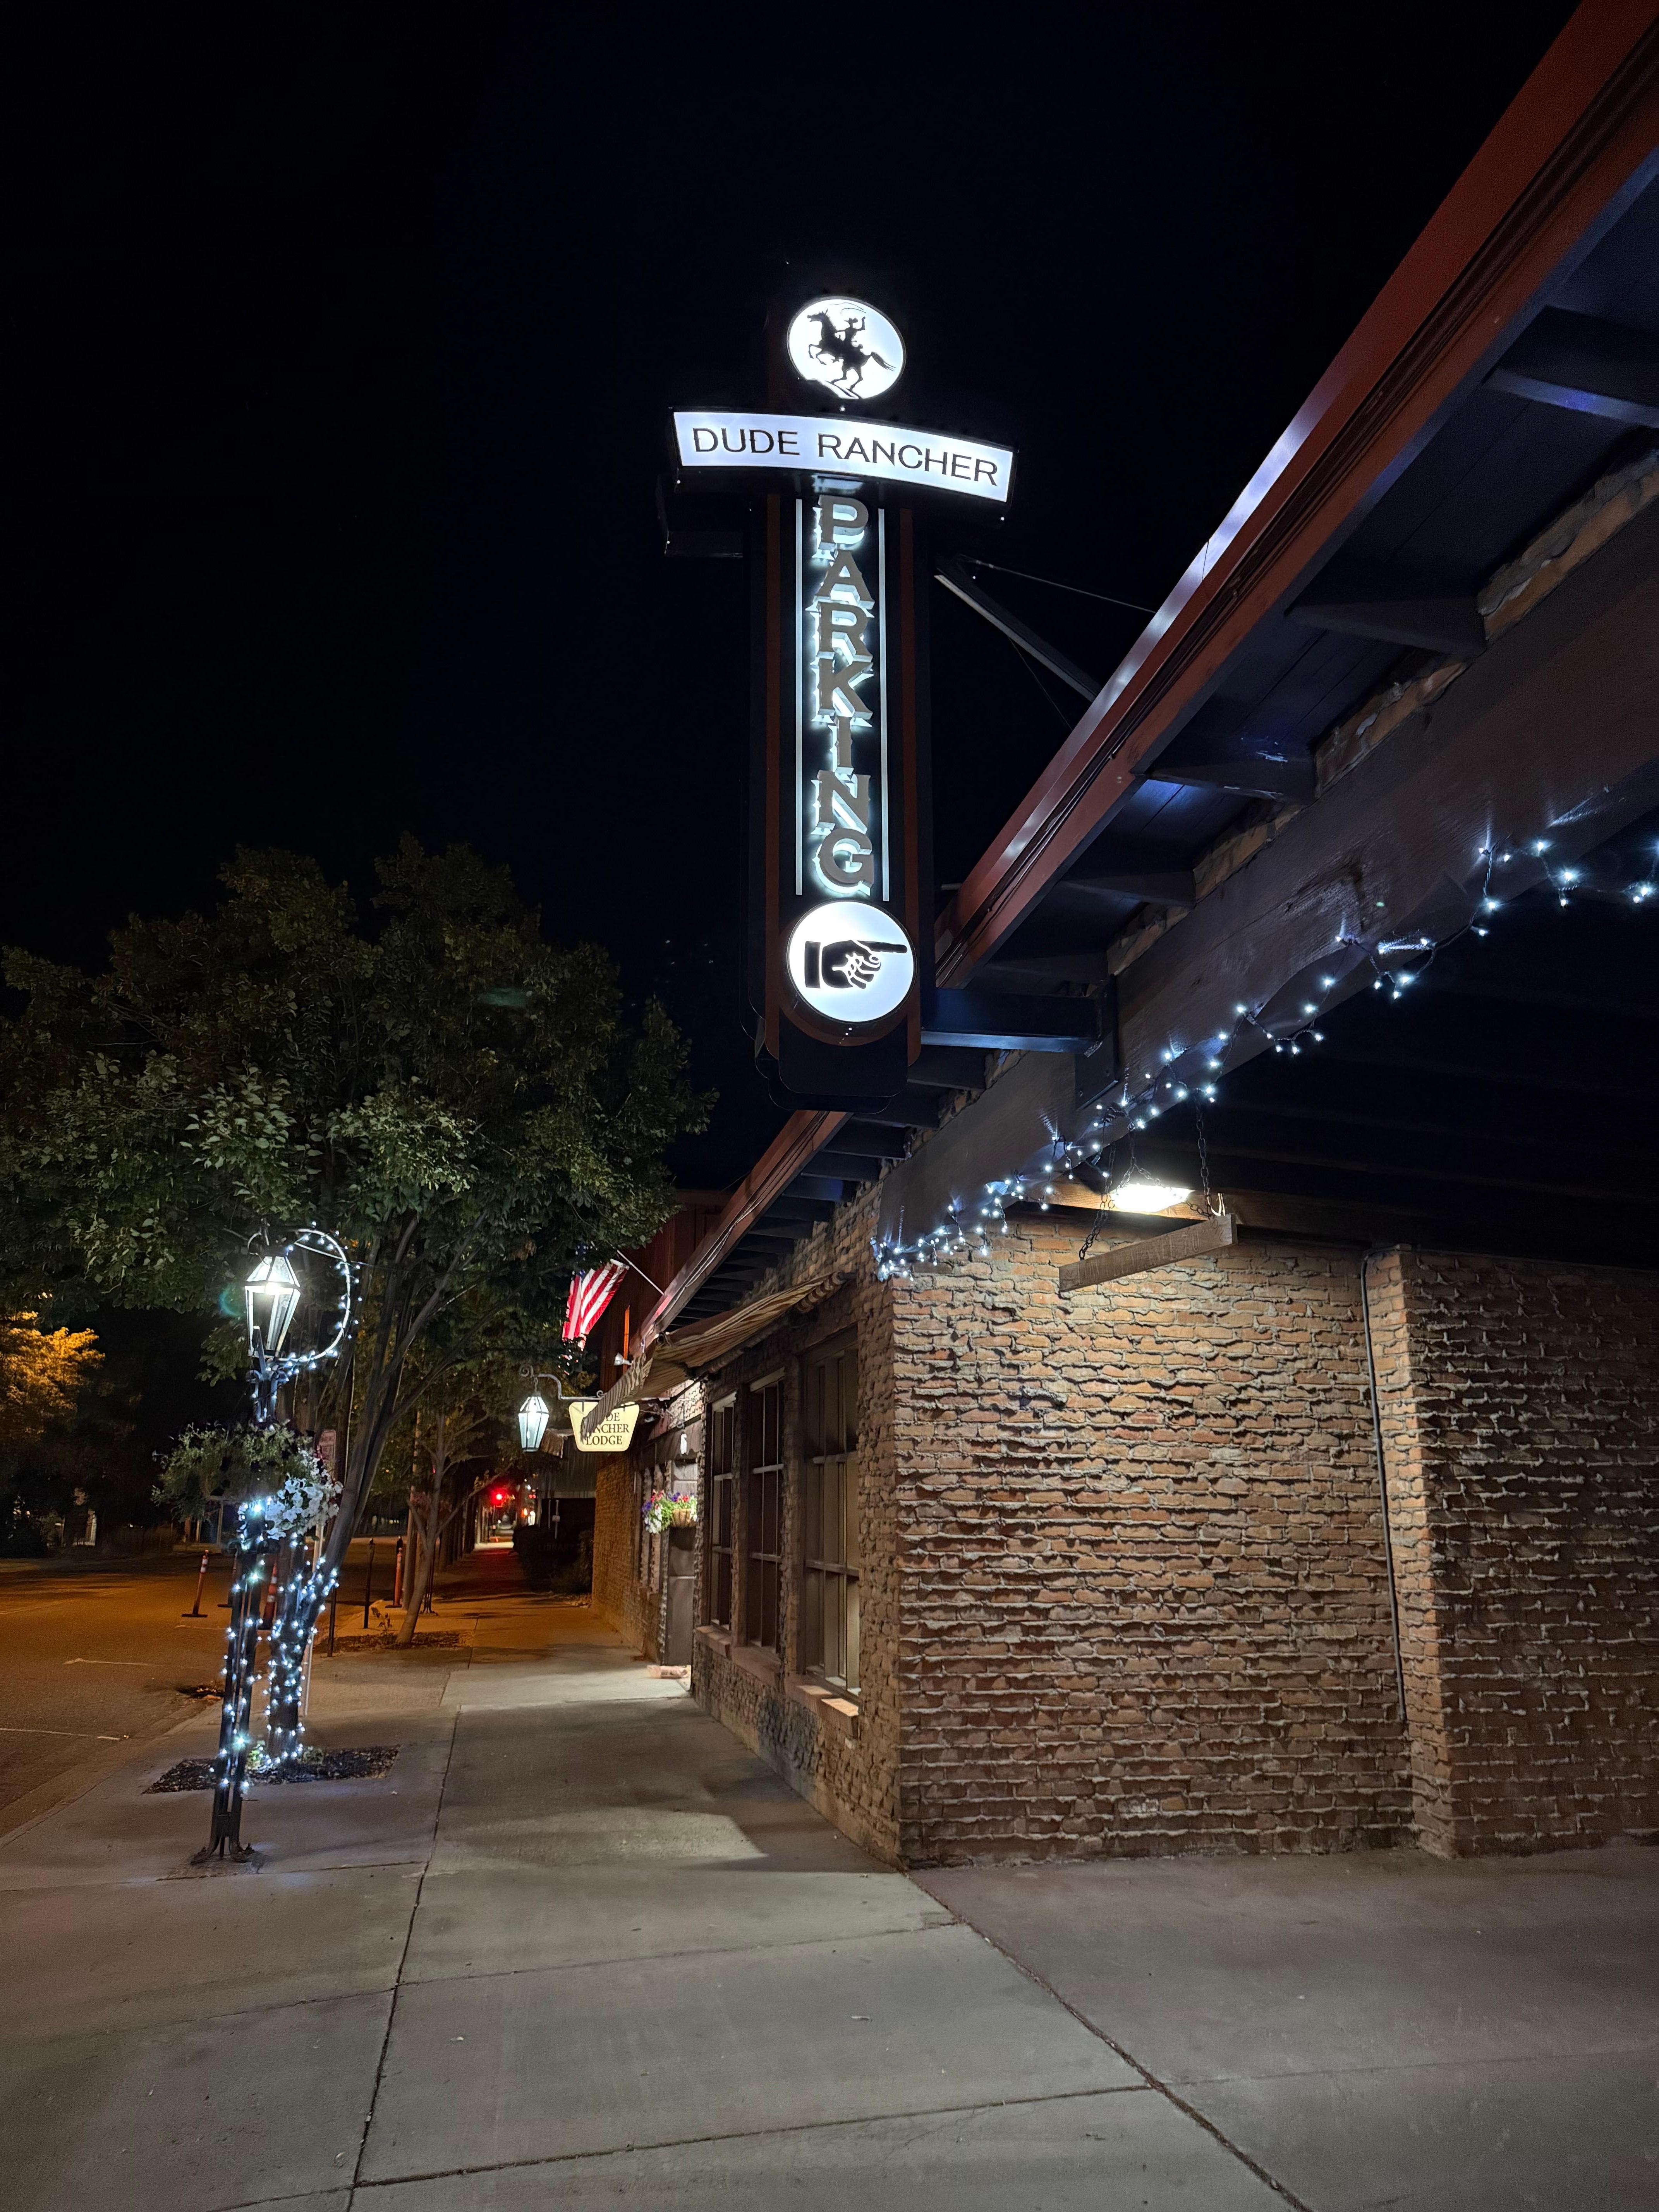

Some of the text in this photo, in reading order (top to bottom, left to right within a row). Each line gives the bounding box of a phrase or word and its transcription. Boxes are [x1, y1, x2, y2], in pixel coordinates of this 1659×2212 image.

[692, 427, 998, 487] DUDE RANCHER
[811, 495, 874, 893] PARKING
[586, 1435, 622, 1445] LODGE
[594, 1424, 630, 1433] NCHER
